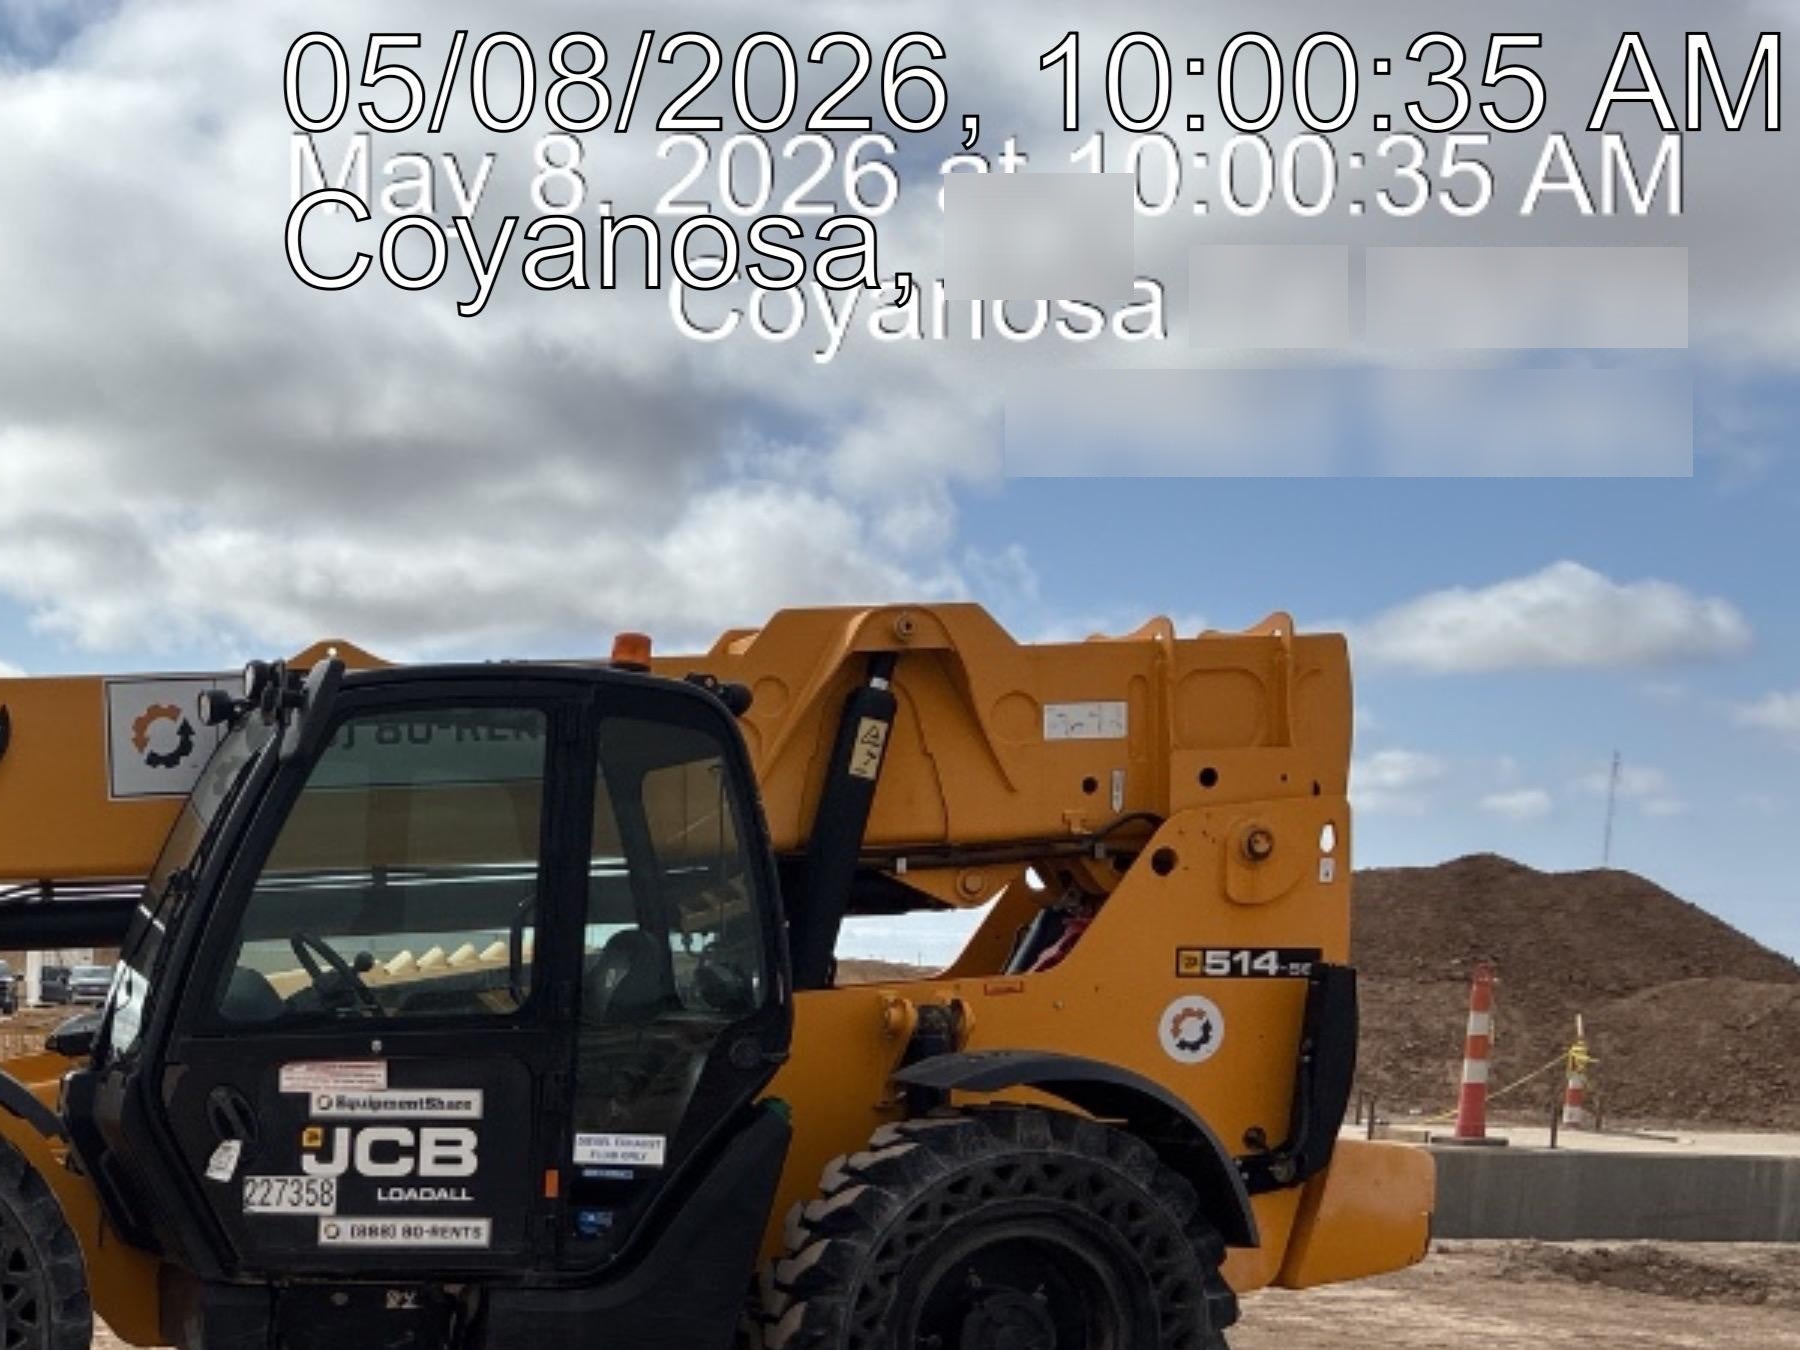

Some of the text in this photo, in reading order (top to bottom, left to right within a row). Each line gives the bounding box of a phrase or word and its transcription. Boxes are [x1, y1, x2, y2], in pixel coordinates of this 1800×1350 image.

[335, 1095, 473, 1113] EquipmentShare
[302, 1126, 479, 1178] JCB
[244, 1178, 335, 1207] 227358
[377, 1187, 474, 1201] LOADALL
